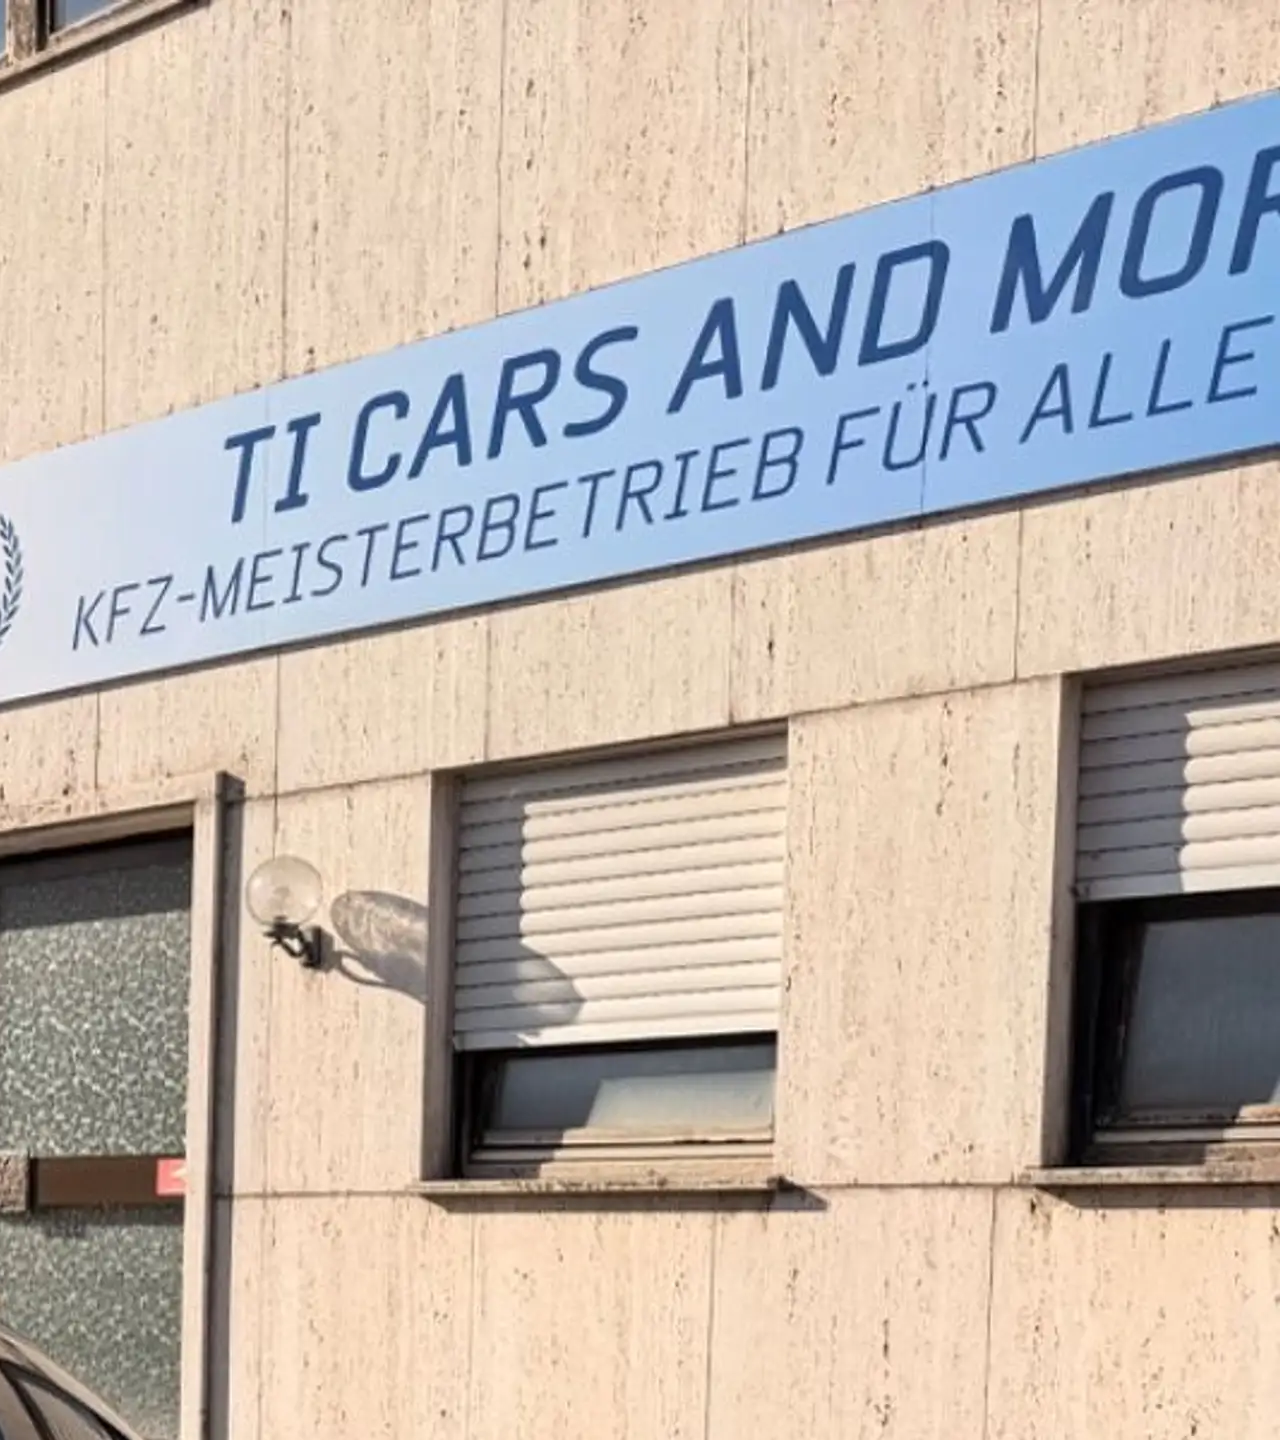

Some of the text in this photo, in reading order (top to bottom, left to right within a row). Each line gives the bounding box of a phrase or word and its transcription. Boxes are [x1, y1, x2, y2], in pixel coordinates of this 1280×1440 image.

[73, 315, 1276, 651] KFZ-MEISTERBETRIEB FÜR ALLE
[224, 412, 320, 523] TI
[347, 325, 639, 491] CARS
[666, 239, 951, 414] AND
